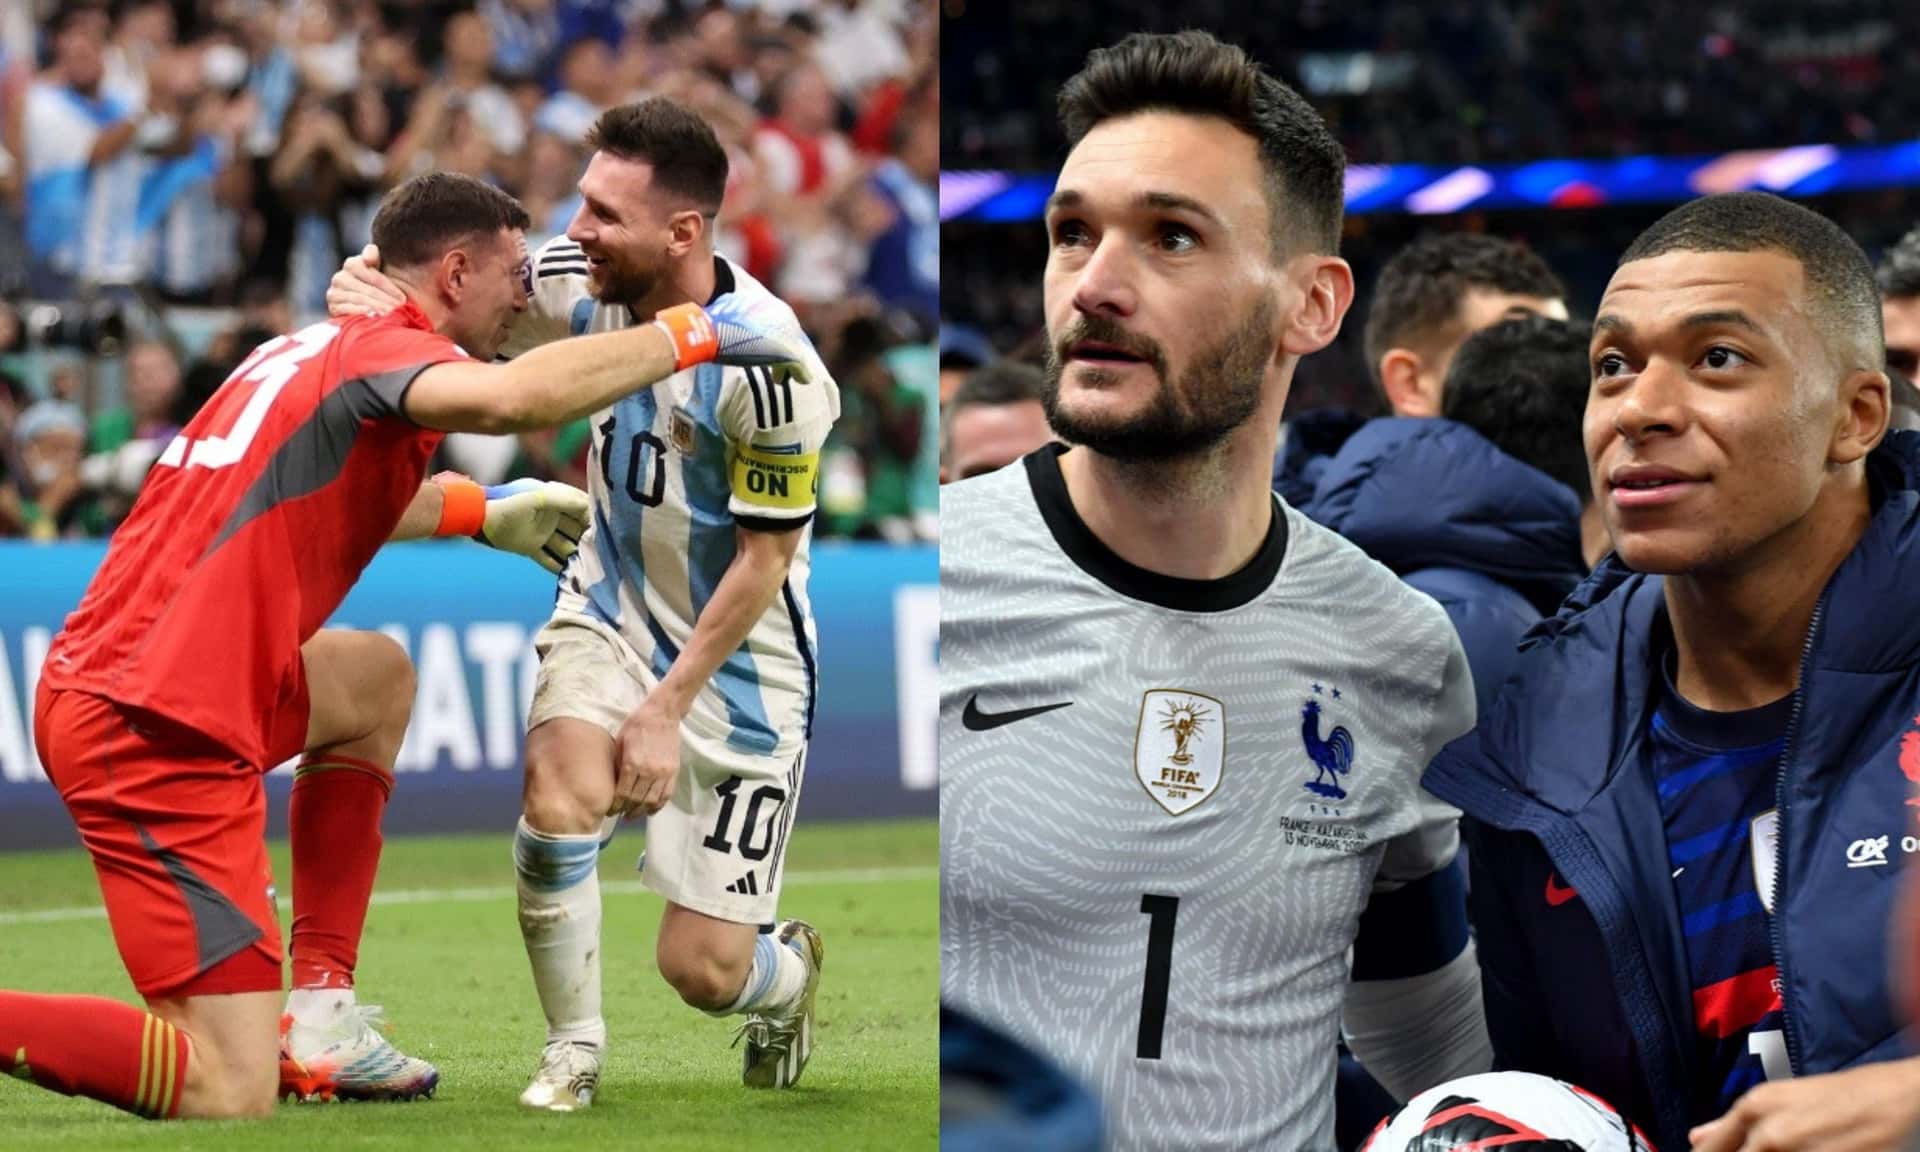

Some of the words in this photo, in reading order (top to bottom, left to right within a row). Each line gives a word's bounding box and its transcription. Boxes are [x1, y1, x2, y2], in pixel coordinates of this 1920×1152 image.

[599, 415, 667, 508] 10
[746, 469, 789, 498] NO
[702, 773, 787, 861] 10
[1160, 767, 1197, 785] FIFA
[1136, 893, 1180, 1060] 1
